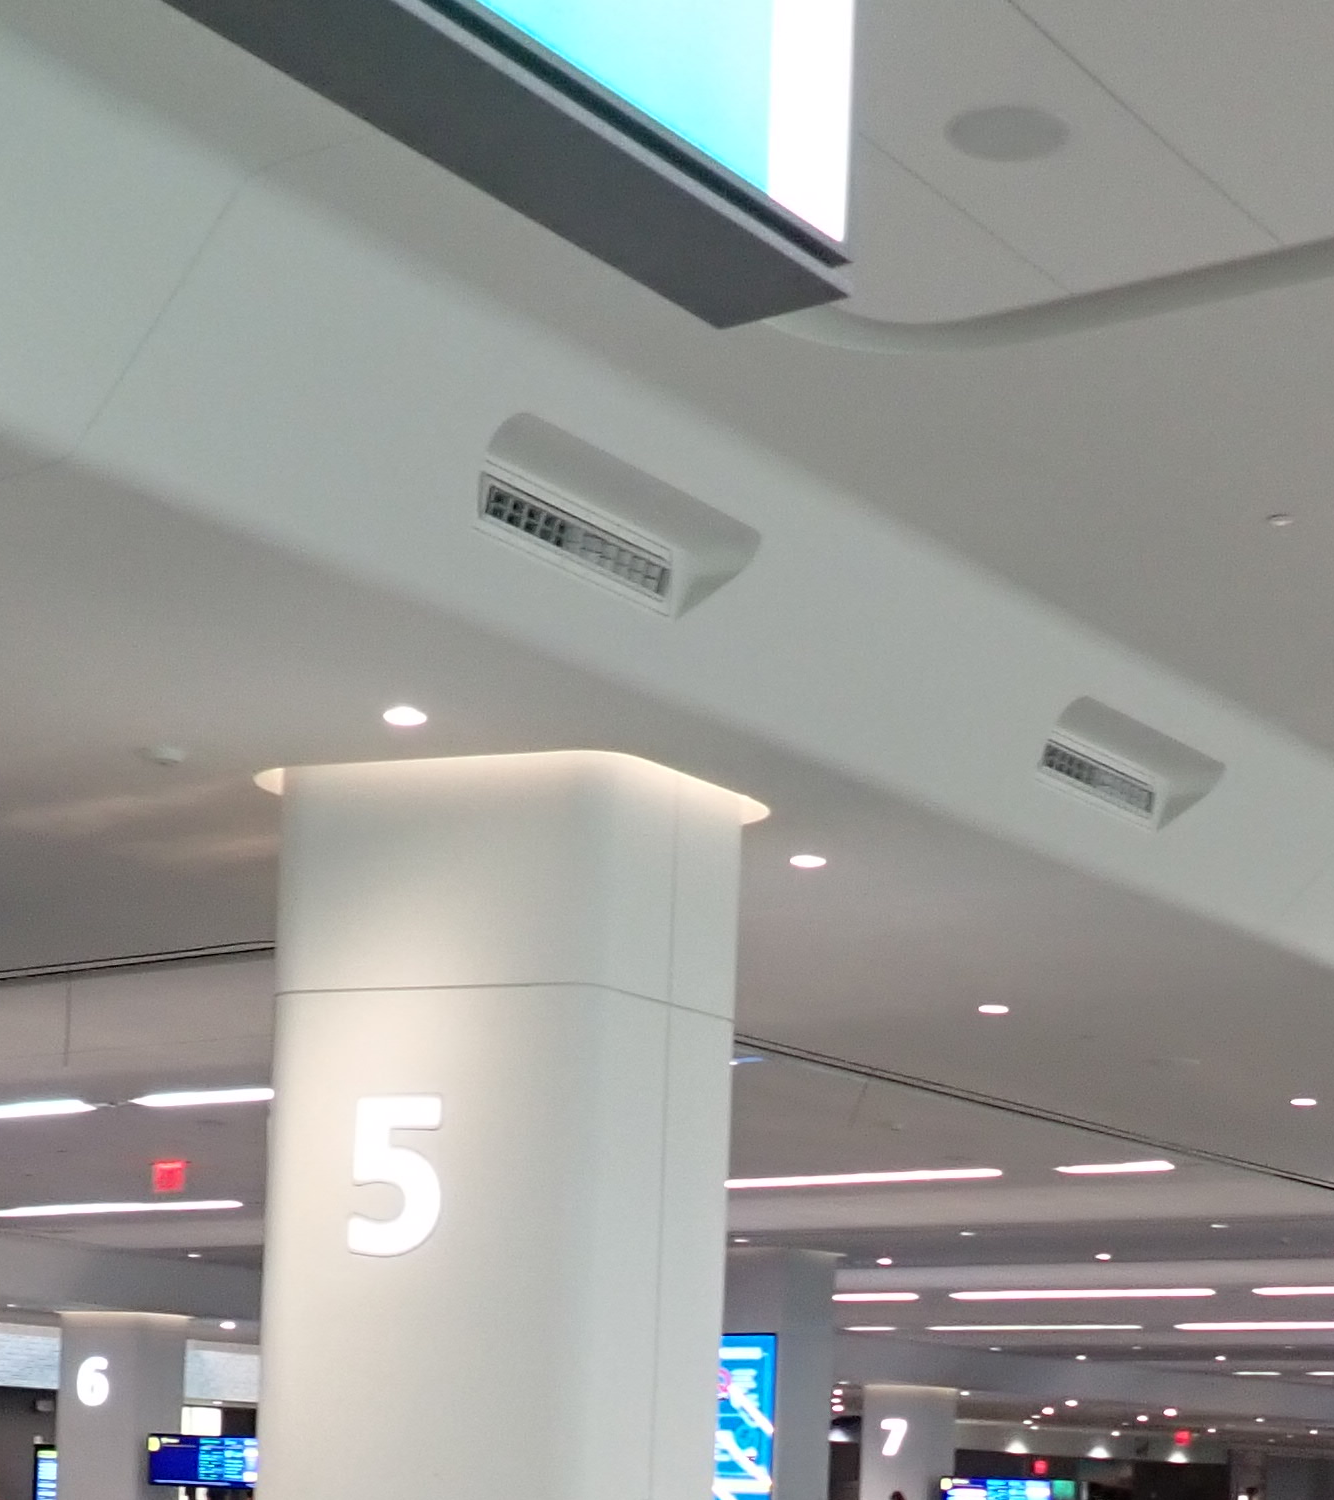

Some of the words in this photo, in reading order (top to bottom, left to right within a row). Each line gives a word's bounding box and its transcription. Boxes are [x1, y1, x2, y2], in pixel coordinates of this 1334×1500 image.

[347, 1094, 442, 1256] 5
[75, 1355, 110, 1407] 6
[880, 1418, 908, 1457] 7
